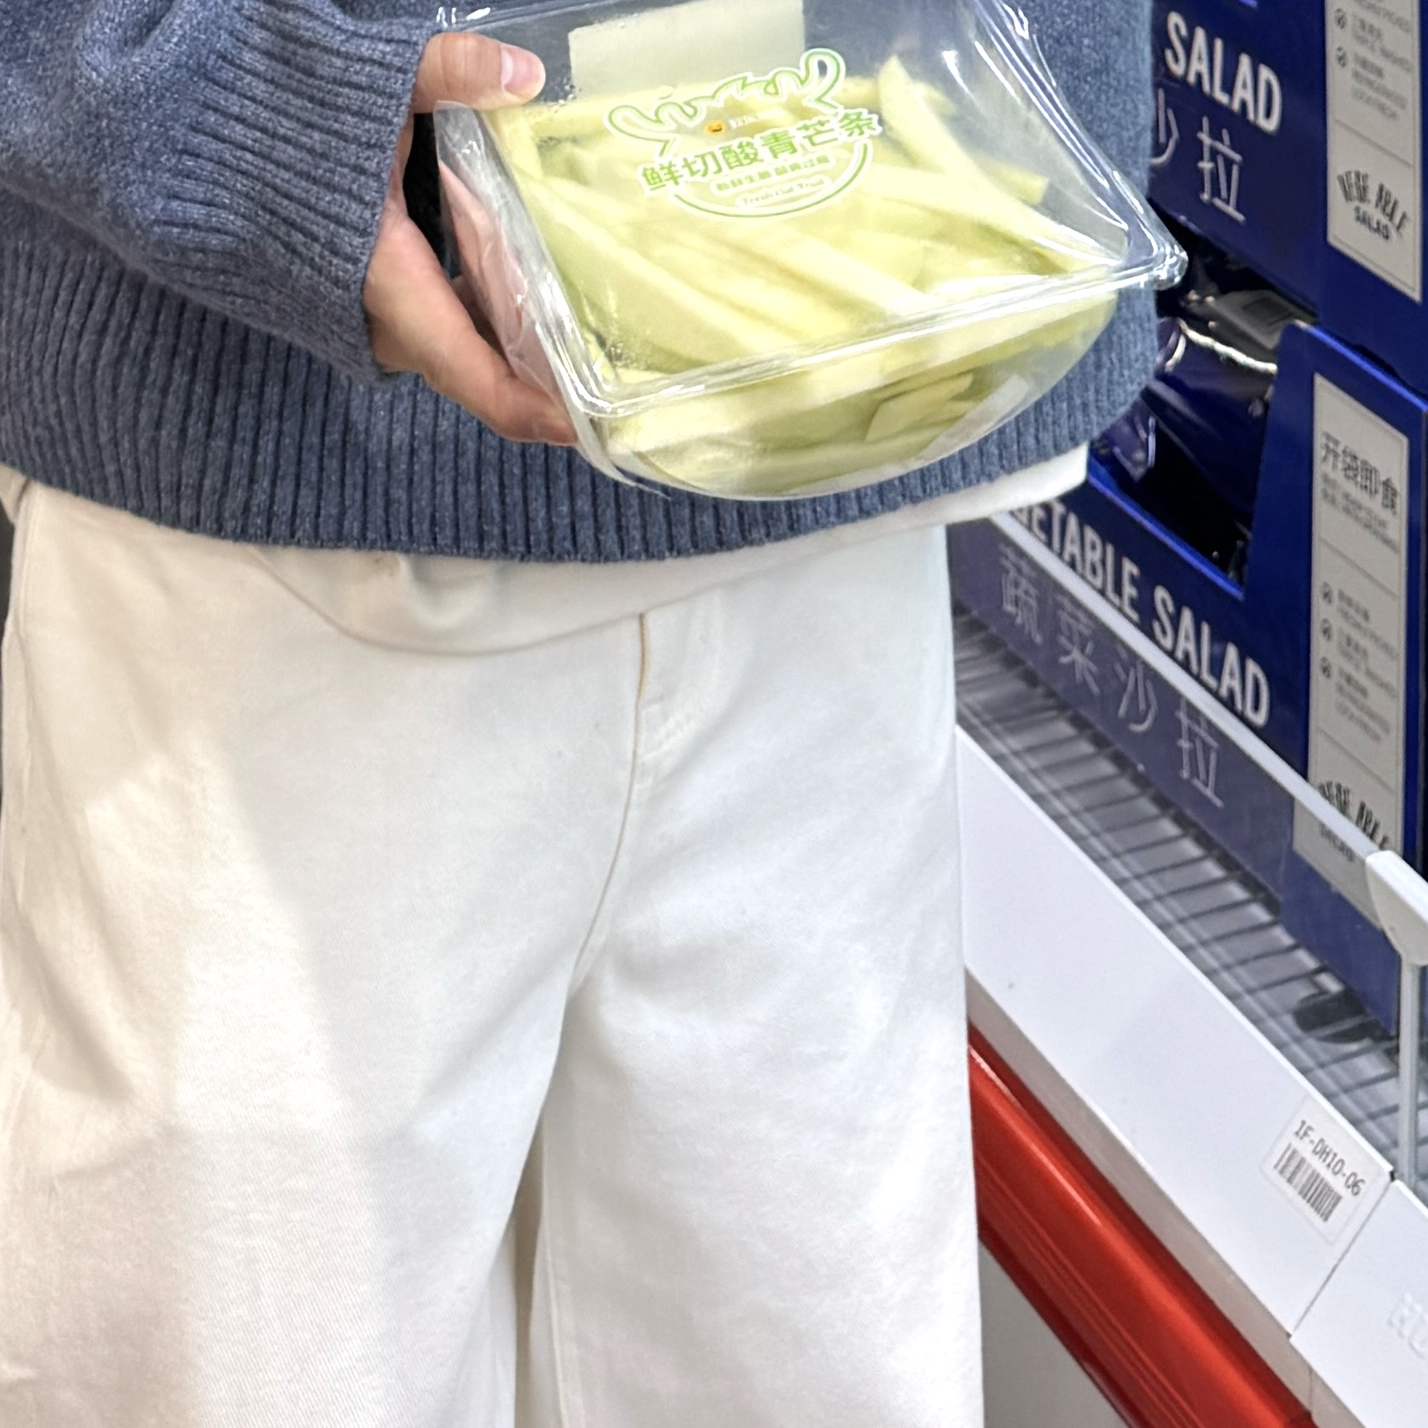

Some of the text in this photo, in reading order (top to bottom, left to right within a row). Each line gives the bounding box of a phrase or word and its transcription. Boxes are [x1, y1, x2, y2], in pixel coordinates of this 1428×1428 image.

[1165, 11, 1282, 135] SALAD
[641, 110, 876, 192] 鲜切酸青芒条
[1152, 584, 1270, 729] SALAD
